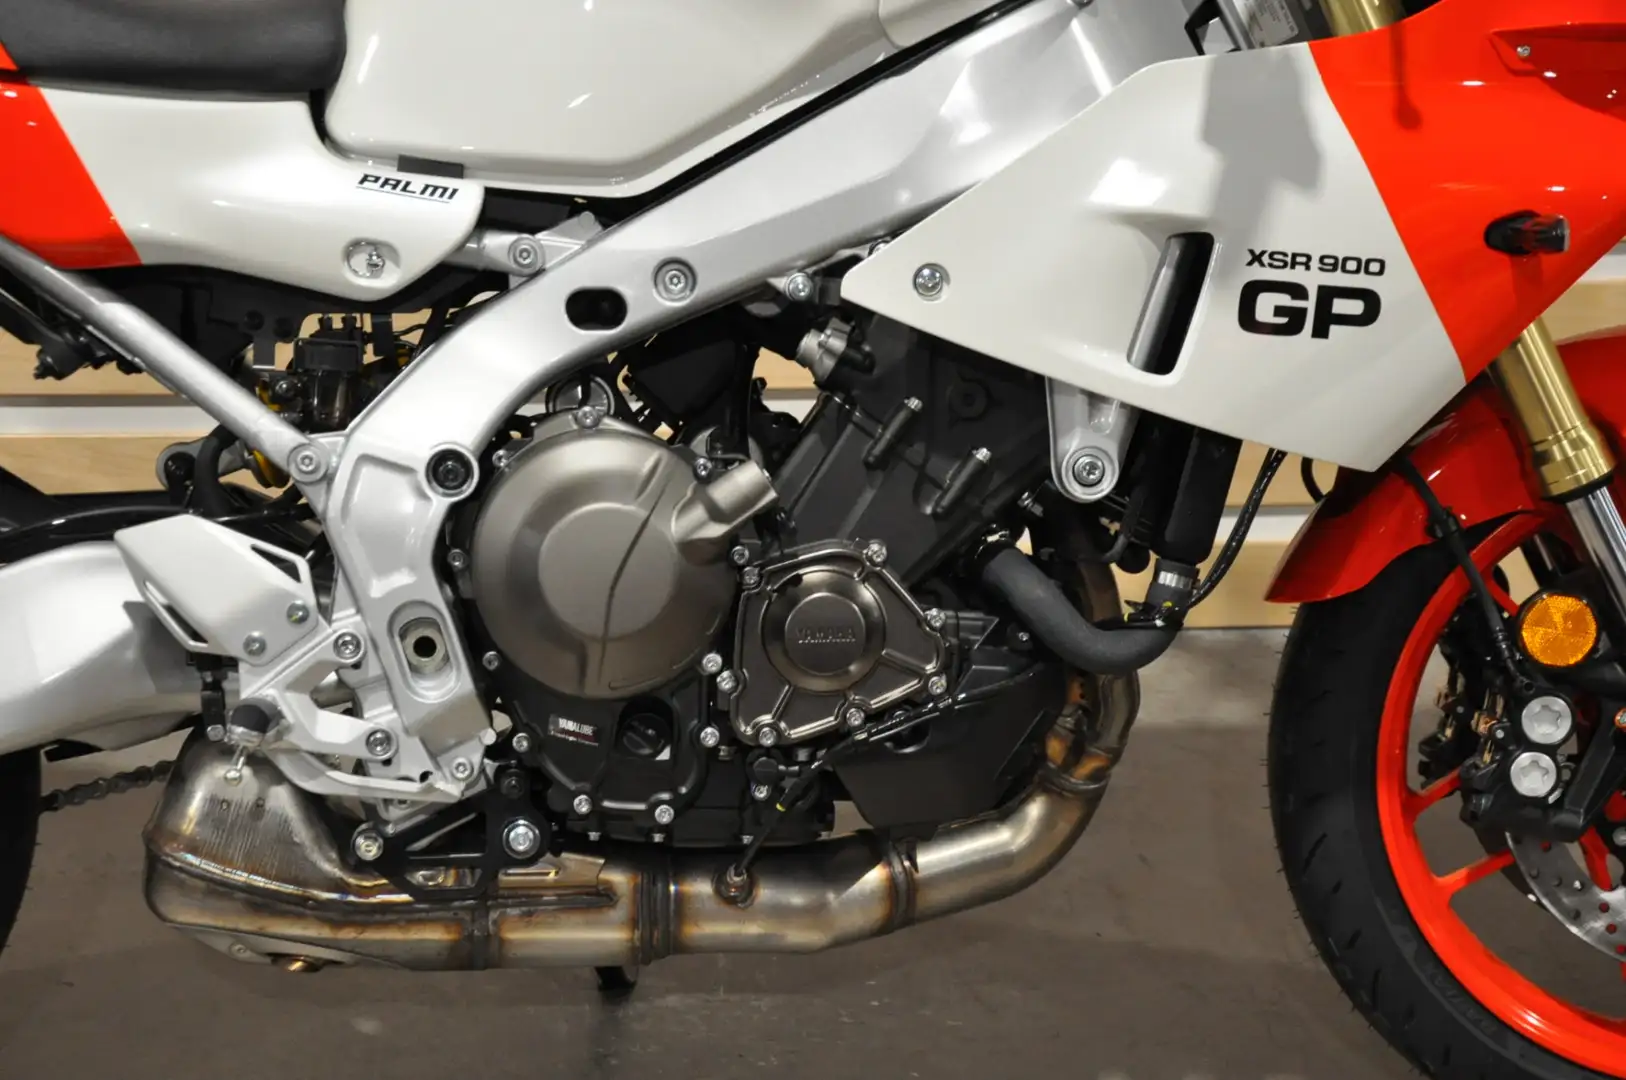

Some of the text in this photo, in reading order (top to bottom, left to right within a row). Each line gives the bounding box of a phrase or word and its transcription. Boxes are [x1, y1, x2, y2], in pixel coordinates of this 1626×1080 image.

[357, 173, 459, 200] PALMI
[1245, 248, 1386, 277] XSR 900
[1237, 279, 1382, 340] GP
[795, 627, 856, 644] YAMAHA
